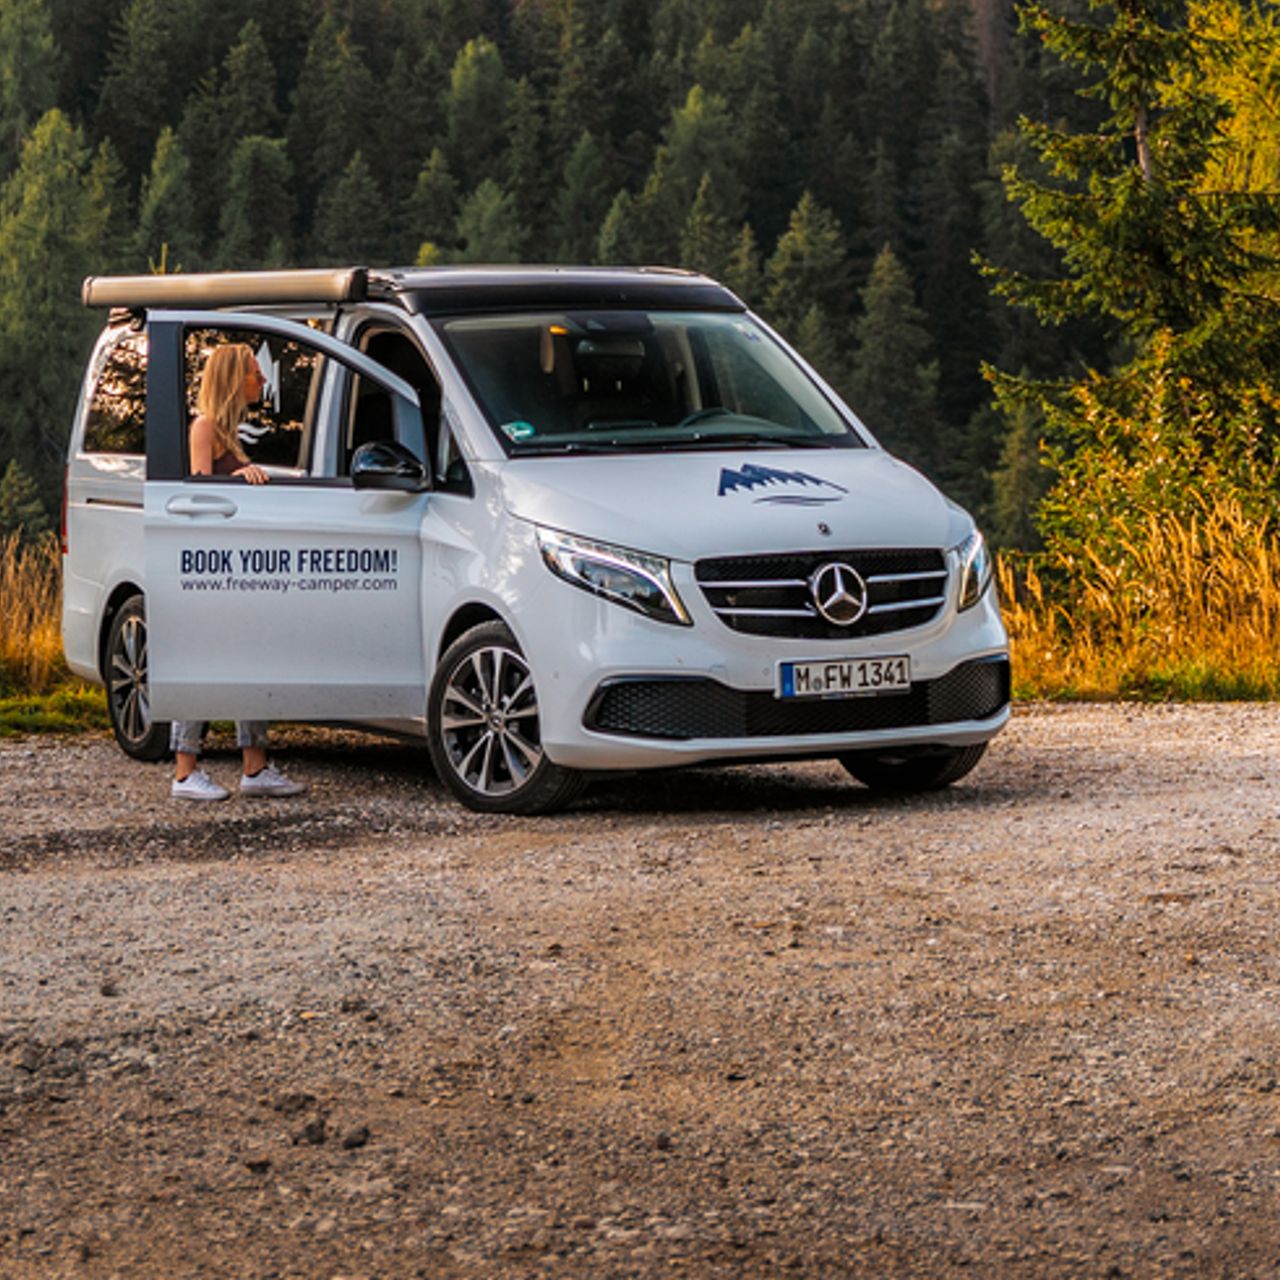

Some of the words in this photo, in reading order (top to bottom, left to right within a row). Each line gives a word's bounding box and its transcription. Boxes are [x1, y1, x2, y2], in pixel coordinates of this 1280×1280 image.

[181, 549, 233, 574] BOOK
[239, 549, 291, 574] YOUR
[297, 549, 398, 573] FREEDOM!
[181, 576, 398, 593] www.freeway-camper.com
[857, 660, 908, 687] 1341
